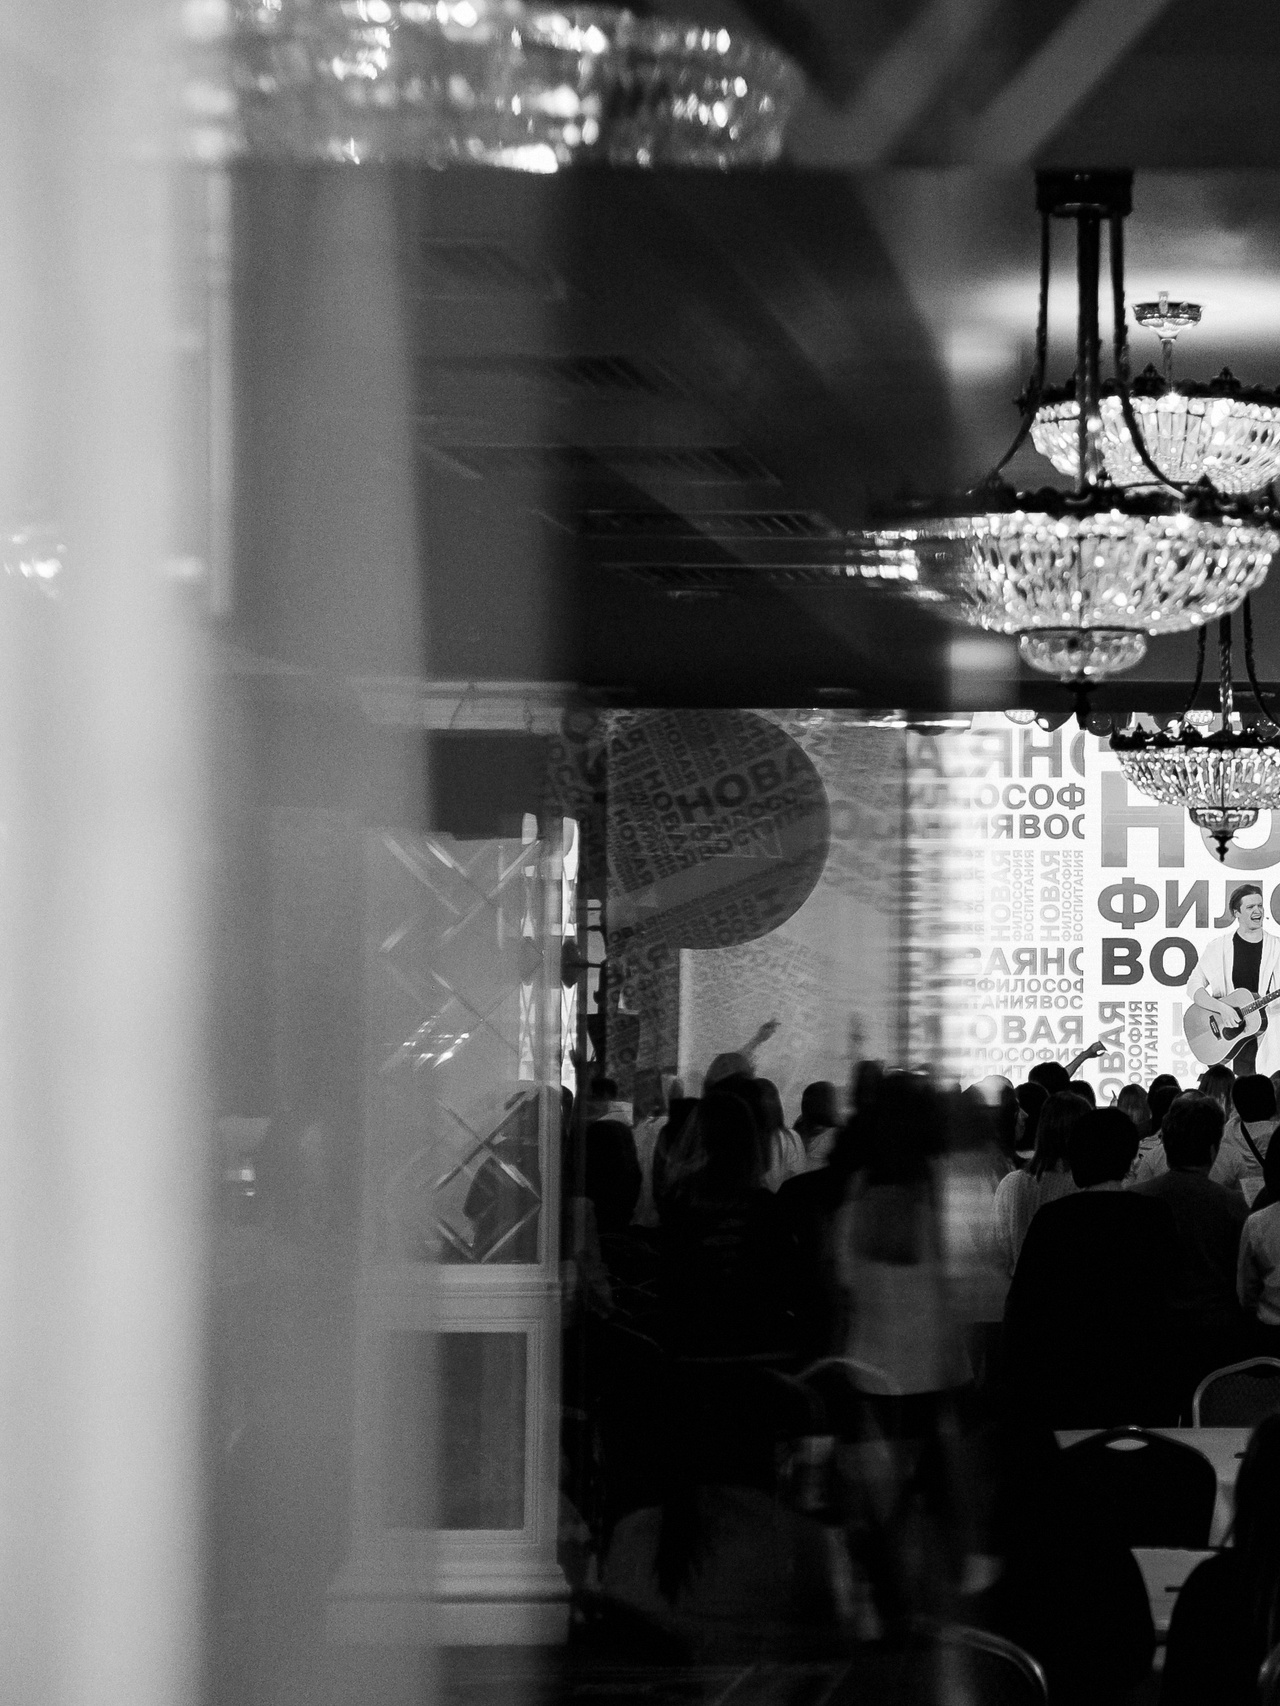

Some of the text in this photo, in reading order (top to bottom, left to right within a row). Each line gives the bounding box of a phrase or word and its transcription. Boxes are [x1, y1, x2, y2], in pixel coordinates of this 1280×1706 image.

[1012, 850, 1023, 942] ФИЛОСОФИЯ
[1023, 850, 1034, 941] ВОСПИТАНИЯ
[1040, 850, 1061, 941] НОВАЯ
[1061, 850, 1072, 942] ФИЛОСОФИЯ
[1073, 850, 1084, 941] ВОСПИТАНИЯ
[967, 1014, 1084, 1044] ОВАЯ
